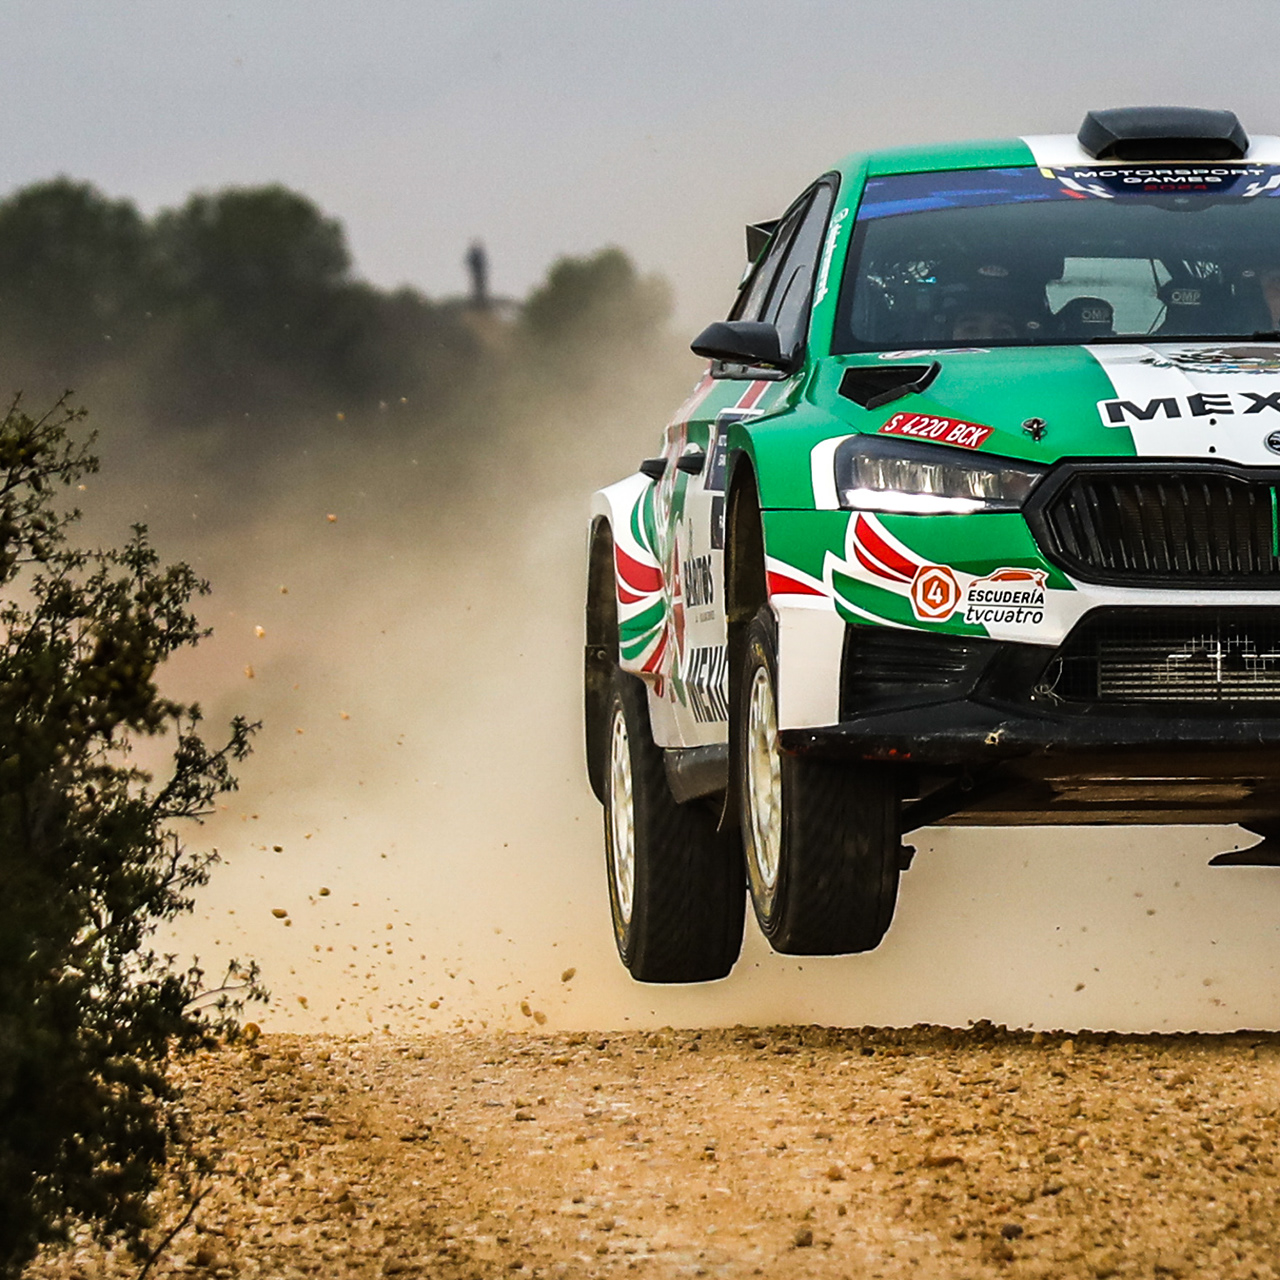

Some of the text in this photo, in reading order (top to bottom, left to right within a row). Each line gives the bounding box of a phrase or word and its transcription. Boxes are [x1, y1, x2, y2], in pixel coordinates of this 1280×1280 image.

[1074, 169, 1264, 178] MOTORSPORT
[1123, 176, 1222, 184] GAMES
[1171, 291, 1200, 301] OMP
[884, 415, 989, 447] S 4220 BCK
[927, 580, 943, 604] 4
[968, 589, 1045, 604] ESCUDERÍA
[966, 605, 1044, 624] tvcuatro
